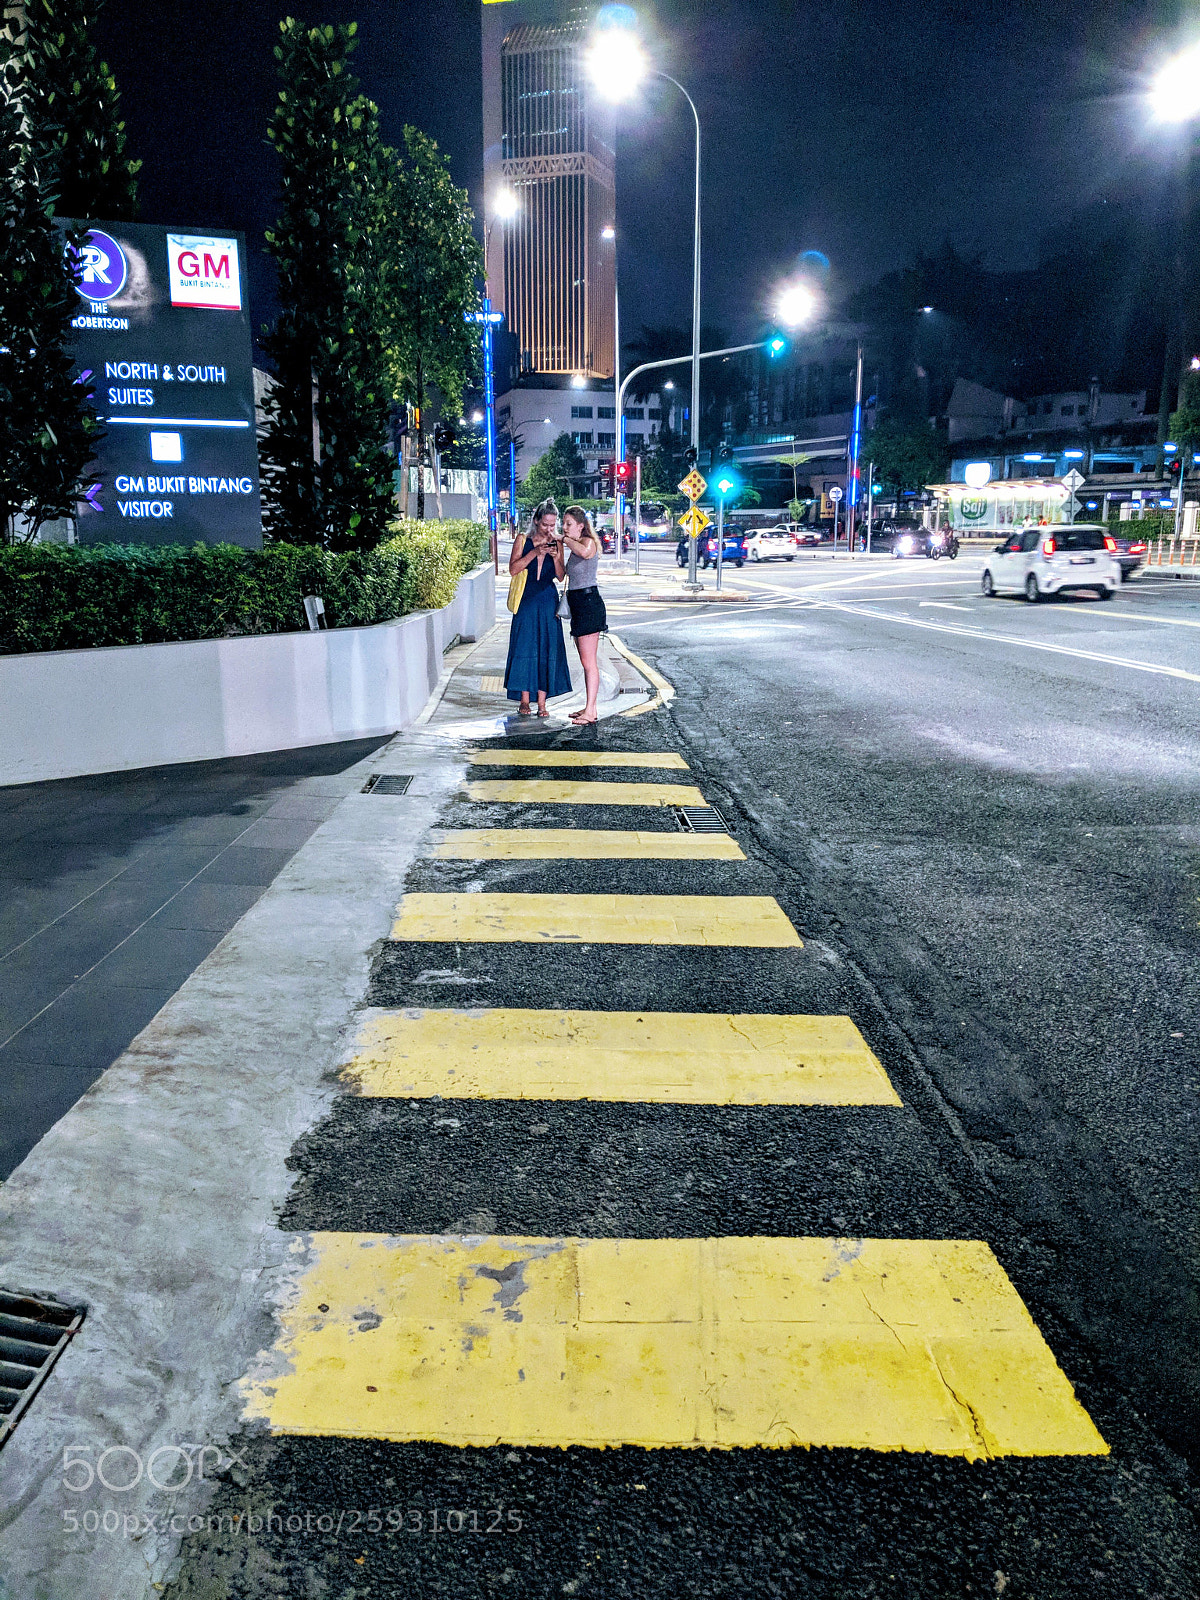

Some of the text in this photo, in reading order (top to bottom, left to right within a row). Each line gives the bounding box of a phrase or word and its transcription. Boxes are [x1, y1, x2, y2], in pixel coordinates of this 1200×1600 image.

[178, 251, 230, 278] GM
[180, 279, 198, 287] BUKIT
[90, 302, 108, 314] THE
[105, 361, 226, 383] NORTH & SOUTH
[108, 387, 154, 405] SUITES
[115, 475, 253, 494] GM BUKIT BINTANG
[117, 500, 173, 517] VISITOR
[962, 497, 985, 515] Saji
